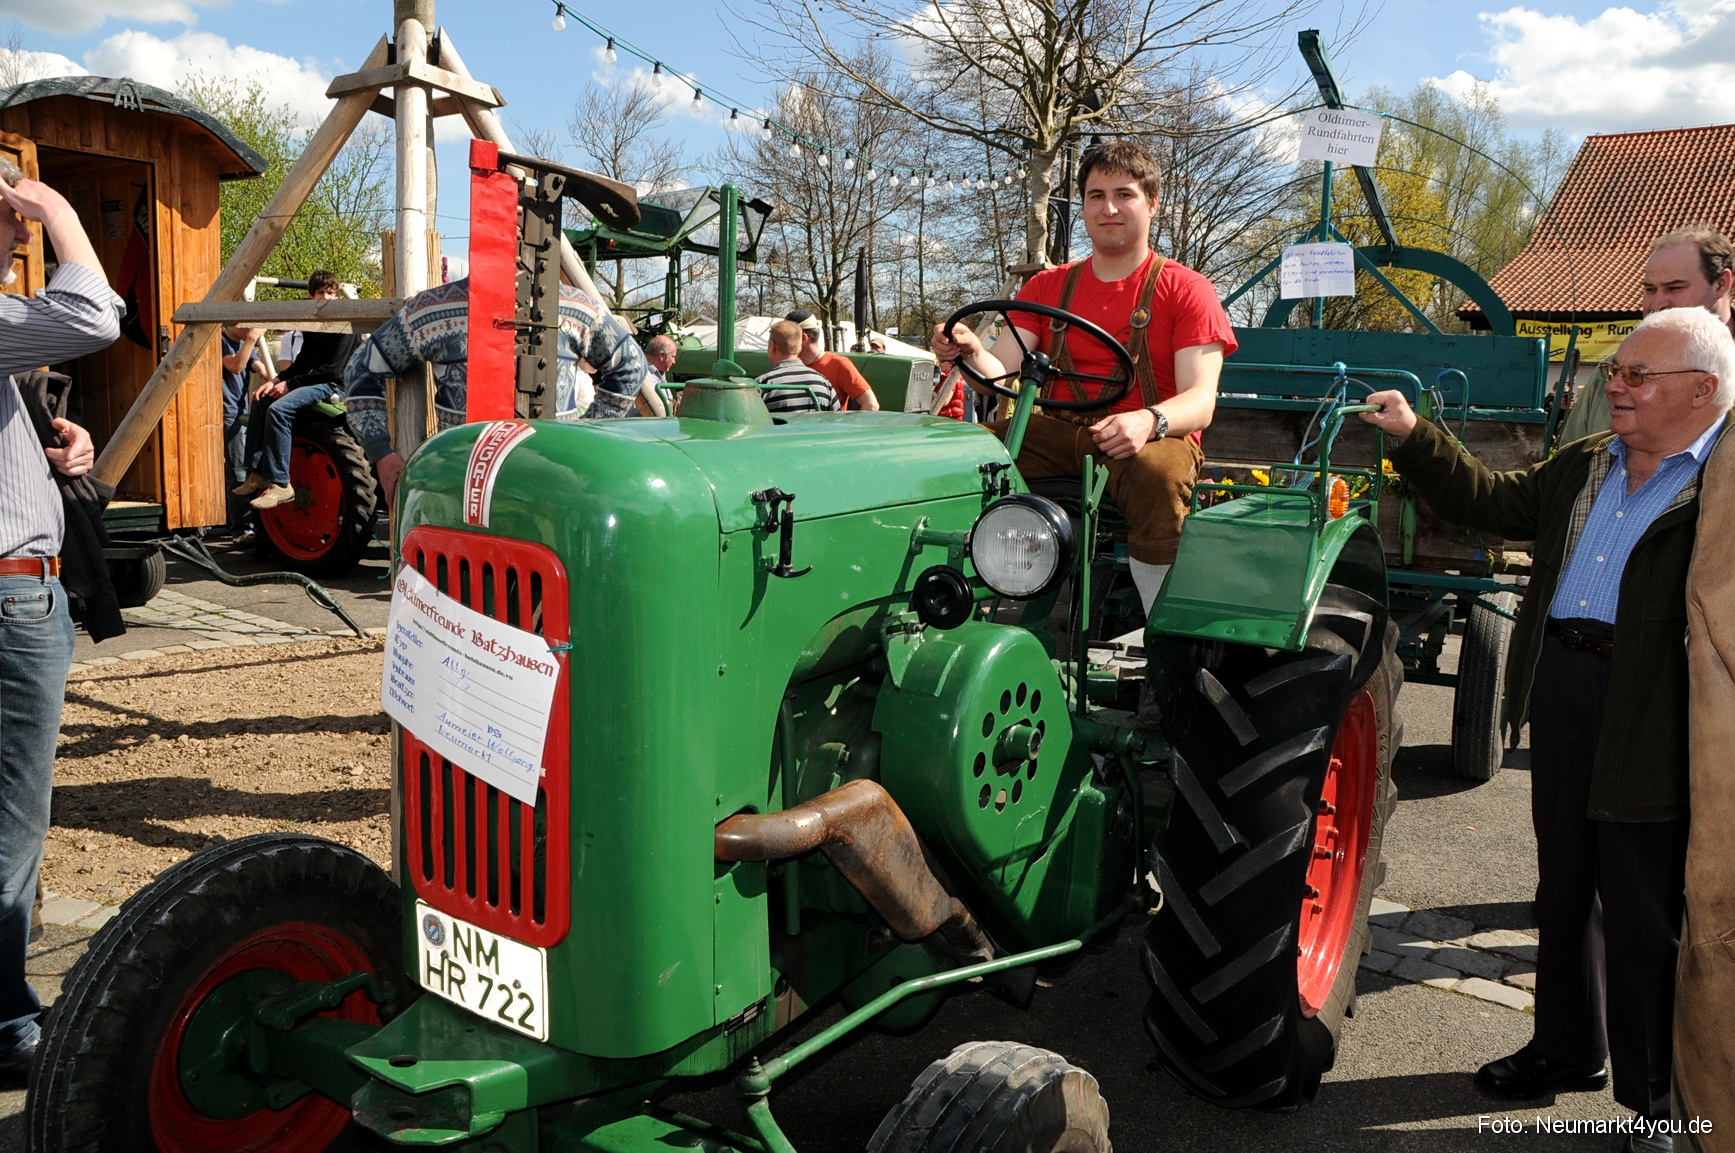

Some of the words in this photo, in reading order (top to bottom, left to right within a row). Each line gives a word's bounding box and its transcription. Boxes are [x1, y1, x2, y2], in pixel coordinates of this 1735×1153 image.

[1318, 112, 1370, 128] Oldtimer-
[1307, 126, 1375, 144] Rundfahrten
[1326, 143, 1349, 156] hier
[1607, 323, 1637, 336] Run
[470, 629, 554, 678] Batzhausen
[453, 921, 499, 976] NM
[426, 950, 466, 1003] HR
[478, 973, 535, 1032] 722
